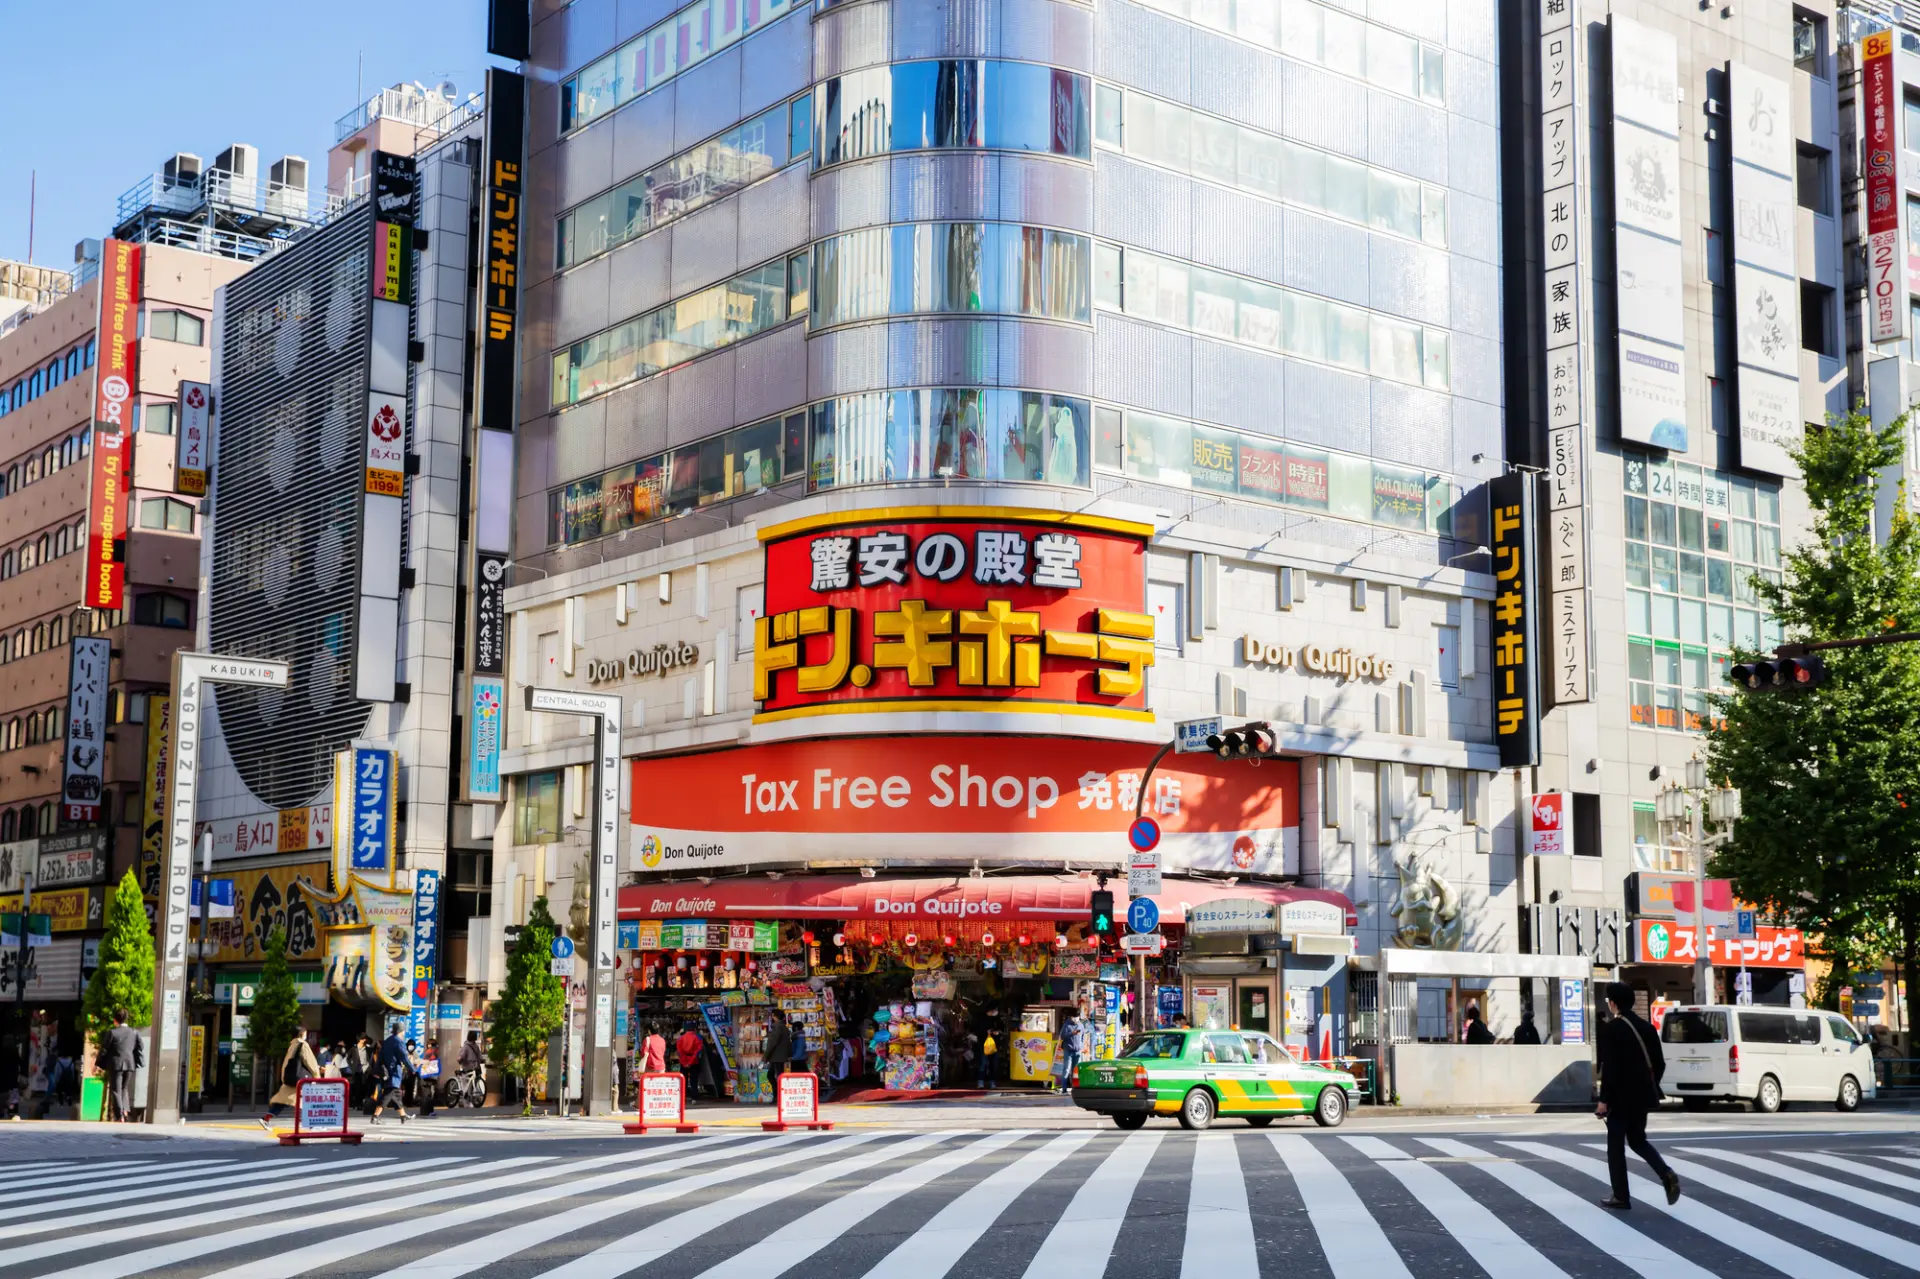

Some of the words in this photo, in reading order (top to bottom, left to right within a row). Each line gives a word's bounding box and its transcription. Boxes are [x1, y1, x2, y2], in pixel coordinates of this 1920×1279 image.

[1866, 37, 1889, 57] 8F
[1550, 40, 1564, 98] ロック
[1550, 118, 1567, 177] アップ
[1625, 197, 1641, 212] THE
[1641, 203, 1674, 221] LOCKUP
[1550, 202, 1568, 252] 北の
[1872, 231, 1896, 249] 全品
[116, 243, 131, 273] free
[389, 228, 398, 285] Garam
[115, 275, 128, 302] wifi
[1874, 246, 1895, 328] 270円均一
[114, 302, 127, 331] free
[1552, 280, 1571, 334] 家族
[111, 335, 126, 370] drink
[1554, 364, 1567, 417] おかか
[1747, 410, 1759, 424] MY
[1761, 414, 1794, 431] オフィス
[104, 455, 119, 476] try
[370, 448, 401, 461] 鳥メロ
[1193, 437, 1233, 472] 販売
[1241, 454, 1281, 477] ブランド
[369, 470, 400, 482] 生ビール
[1288, 462, 1326, 485] 時計
[1555, 434, 1568, 505] ESOLA
[105, 478, 115, 503] our
[1373, 474, 1424, 500] don.quijote
[101, 503, 115, 560] capsule
[810, 531, 1083, 592] 驚安の殿堂
[1559, 516, 1575, 582] ふぐ一郎
[99, 564, 114, 604] booth
[1244, 634, 1297, 667] Don
[1303, 644, 1396, 683] Quijote
[1563, 596, 1578, 698] ミステリアス
[587, 659, 622, 684] Don
[625, 643, 697, 676] Quijote
[536, 695, 579, 707] CENTRAL
[581, 698, 607, 709] ROAD
[170, 702, 196, 847] GODZILLA
[742, 774, 799, 814] Tax
[813, 768, 911, 809] Free
[928, 764, 1059, 818] Shop
[1077, 770, 1182, 816] 免税店
[70, 806, 94, 821] B1
[281, 812, 308, 829] 生ビール
[311, 806, 330, 825] 入口
[357, 755, 385, 863] カラオケ
[235, 820, 274, 852] 鳥メロ
[604, 757, 618, 930] ゴジラロード
[1534, 842, 1560, 852] ドラッグ
[1540, 833, 1557, 842] スギ
[664, 846, 683, 859] Don
[686, 843, 724, 858] Quijote
[89, 897, 102, 920] 2F
[168, 866, 189, 934] ROAD
[650, 899, 672, 914] Don
[674, 898, 716, 916] Quijote
[874, 898, 916, 914] Don
[922, 897, 1003, 919] Quijote
[415, 874, 438, 961] カラオケ
[1134, 906, 1146, 928] P
[1195, 911, 1267, 921] 安全安心ステーション
[1742, 913, 1749, 925] P
[415, 965, 433, 979] B1
[1564, 985, 1574, 1007] P
[760, 1082, 773, 1093] マス
